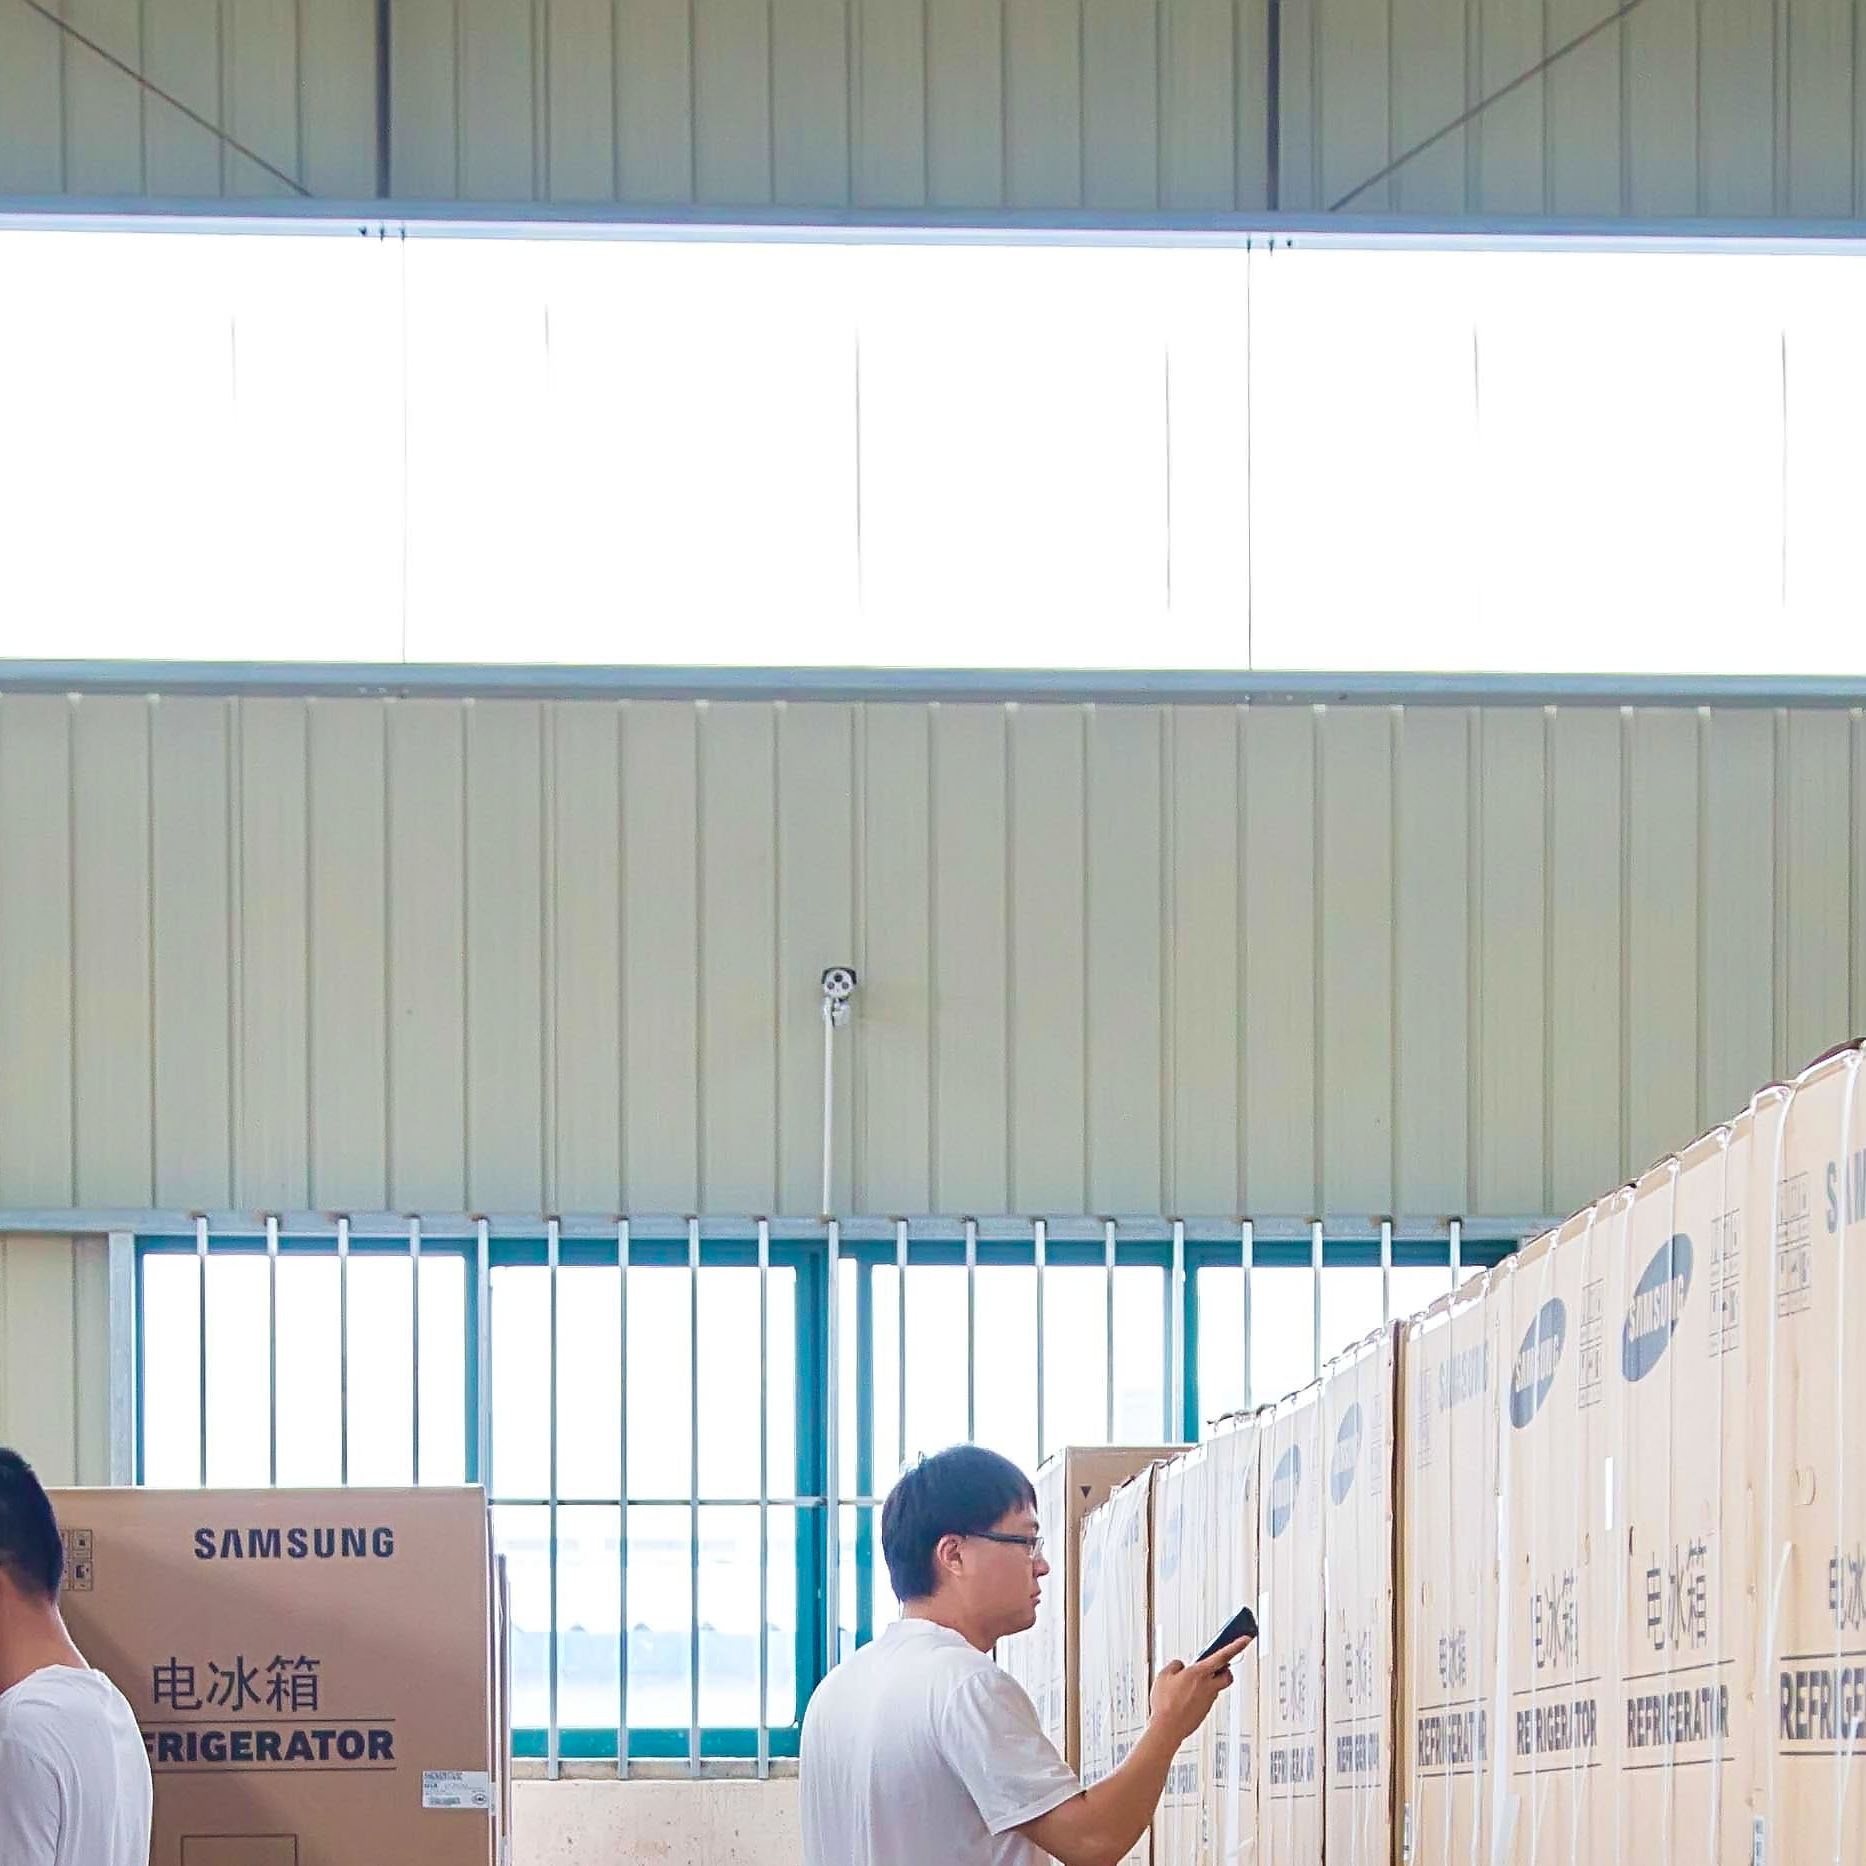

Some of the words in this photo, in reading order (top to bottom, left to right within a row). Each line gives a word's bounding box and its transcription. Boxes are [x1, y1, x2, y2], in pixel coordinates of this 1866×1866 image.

[194, 1527, 394, 1559] SAMSUNG
[152, 1654, 321, 1714] 电冰箱
[1516, 1698, 1598, 1757] RERIGERATOR
[1625, 1684, 1729, 1749] REFRIGERATR
